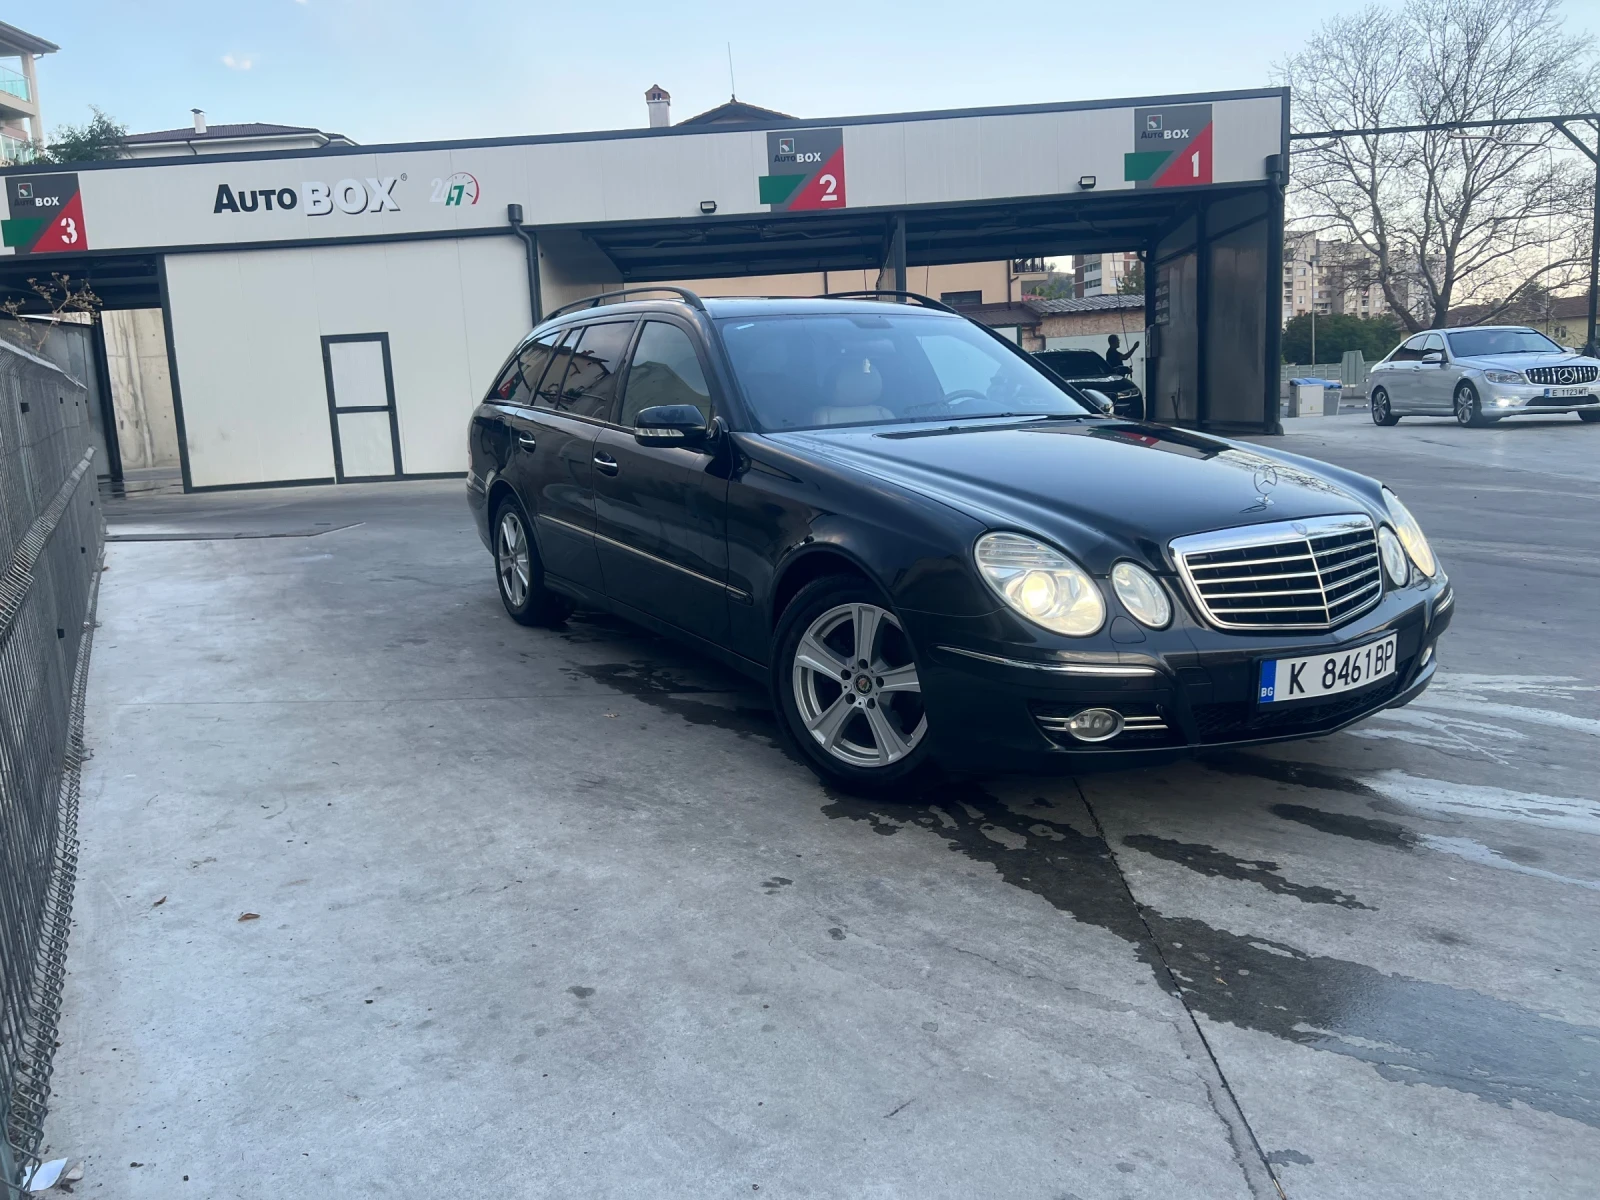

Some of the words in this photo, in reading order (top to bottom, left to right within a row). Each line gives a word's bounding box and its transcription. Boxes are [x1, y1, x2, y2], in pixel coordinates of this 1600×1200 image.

[1191, 150, 1199, 177] 1
[819, 174, 838, 201] 2
[60, 217, 78, 244] 3
[1289, 661, 1308, 695] K
[1261, 687, 1274, 697] BG
